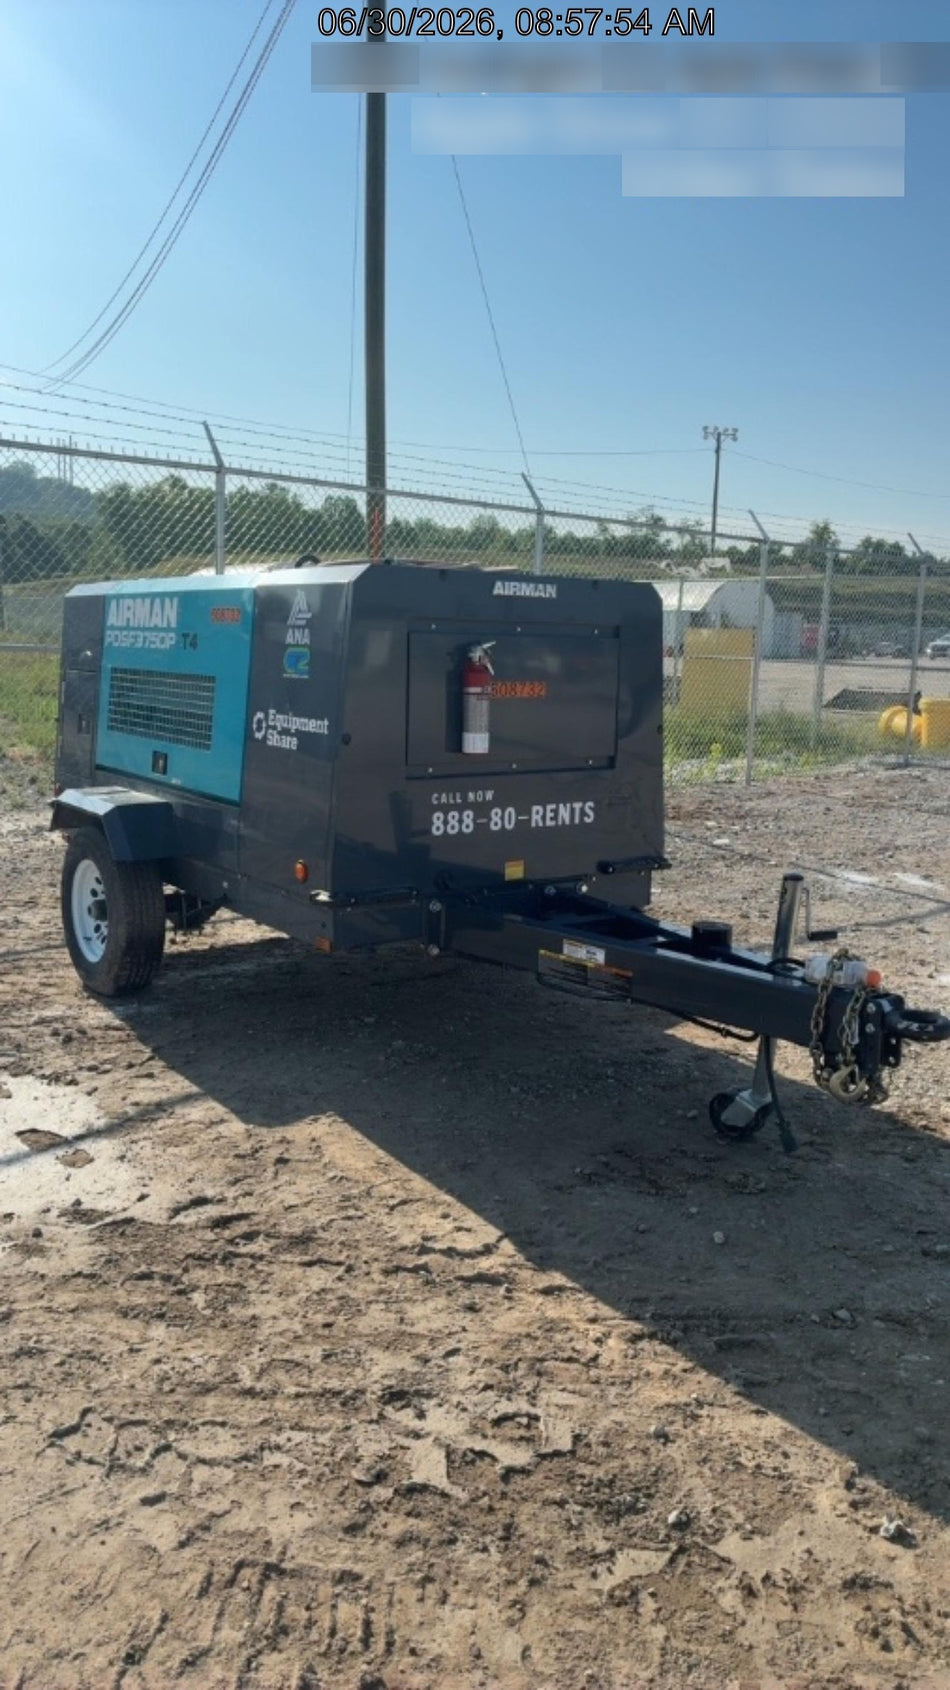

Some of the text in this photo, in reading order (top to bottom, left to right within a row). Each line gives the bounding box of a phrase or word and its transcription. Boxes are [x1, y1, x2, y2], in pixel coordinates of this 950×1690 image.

[492, 580, 557, 598] AIRMAN
[106, 597, 179, 628] AIRMAN
[285, 628, 310, 645] ANA
[268, 709, 329, 735] Equipment
[266, 729, 298, 750] Share
[431, 789, 494, 804] CALL NOW
[431, 801, 595, 836] 888-80-RENTS
